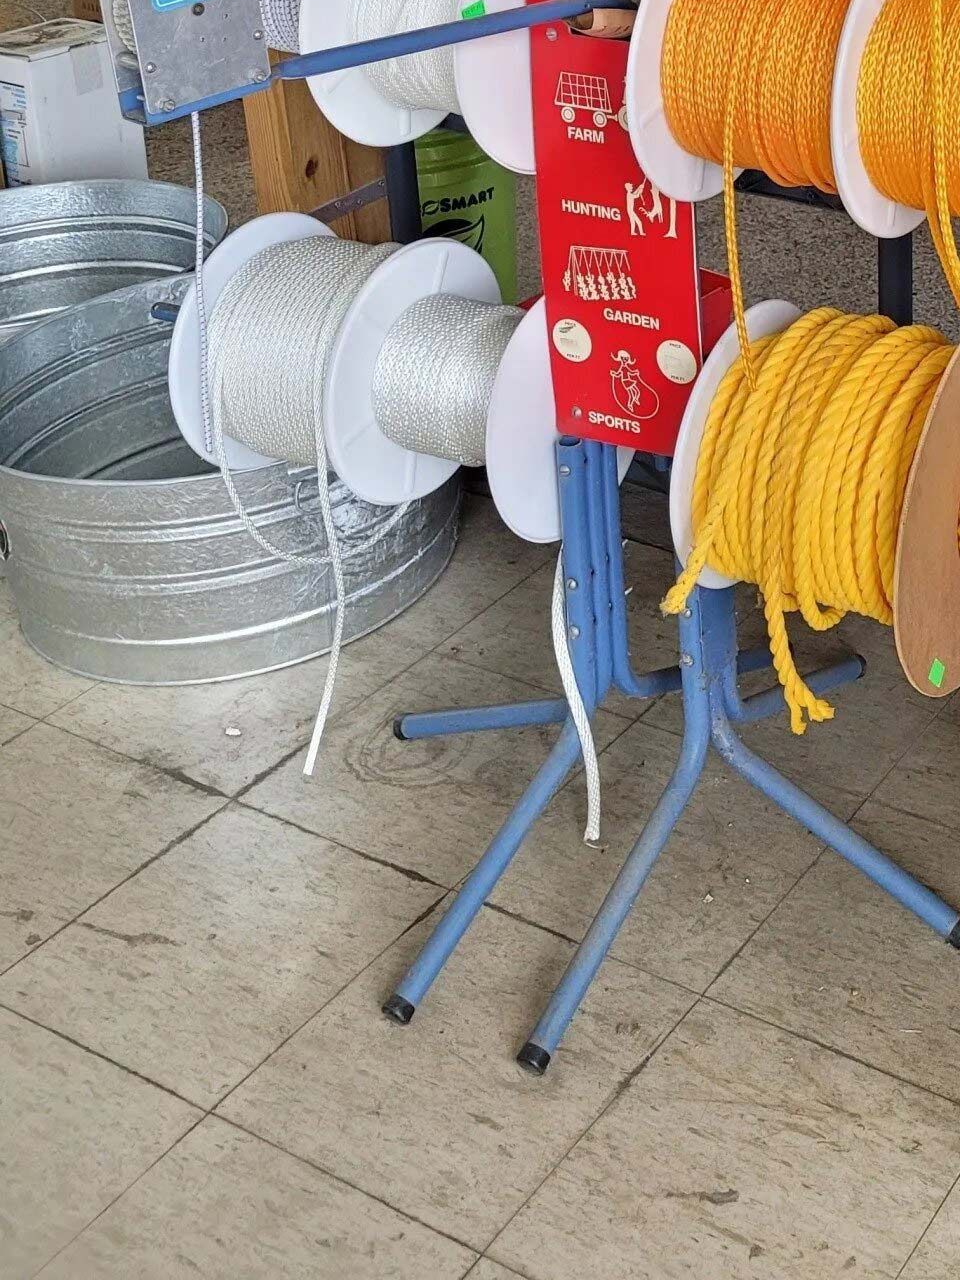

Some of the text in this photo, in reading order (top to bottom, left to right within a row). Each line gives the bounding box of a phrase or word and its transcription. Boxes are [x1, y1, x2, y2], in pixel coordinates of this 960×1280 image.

[567, 126, 605, 144] FARM
[561, 199, 622, 221] HUNTING
[603, 308, 660, 331] GARDEN
[588, 411, 641, 434] SPORTS
